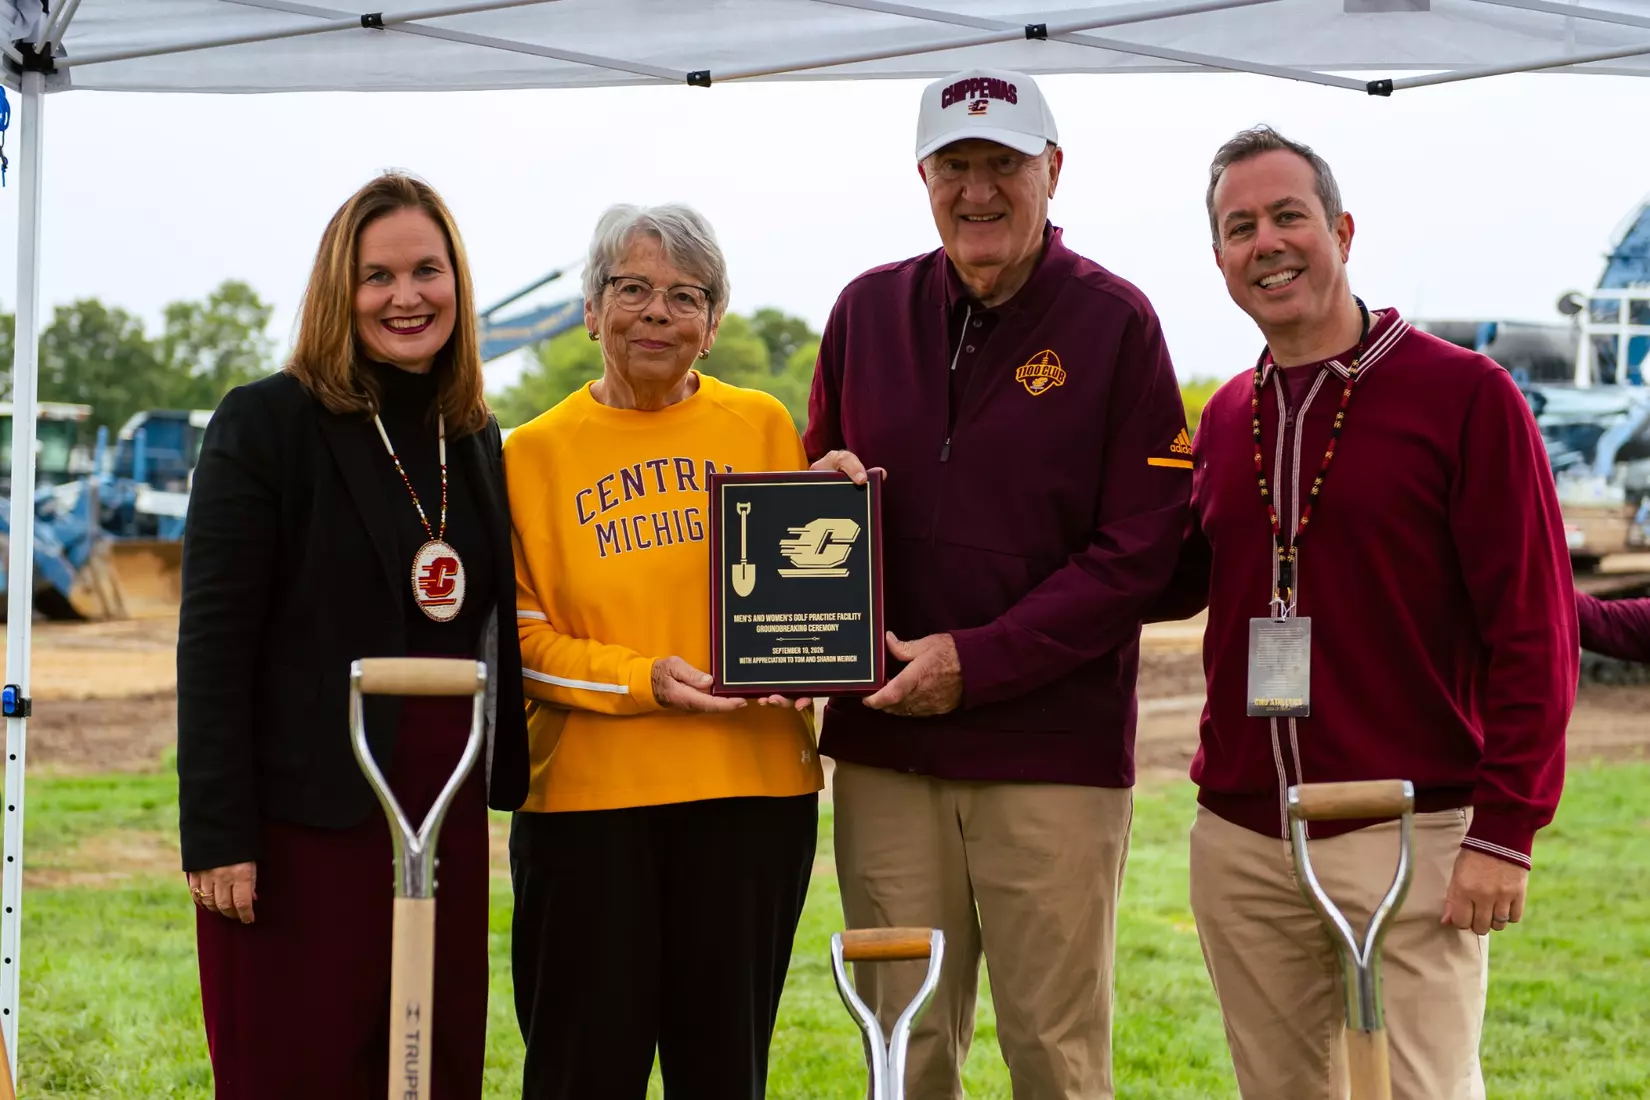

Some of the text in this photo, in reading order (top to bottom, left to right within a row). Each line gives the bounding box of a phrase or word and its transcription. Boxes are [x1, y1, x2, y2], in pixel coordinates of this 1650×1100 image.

[942, 77, 1017, 109] CHIPPEWAS
[1018, 366, 1064, 382] 1100 CLUB
[575, 457, 733, 526] CENTRA
[595, 507, 709, 558] MICHIG
[734, 612, 861, 623] MEN'S AND WOMEN'S GOLF PRACTICE FACILITY
[756, 624, 839, 633] GROUNDBREAKING CEREMONY
[772, 647, 801, 655] SEPTEMBER
[753, 656, 787, 664] APPRECIATION
[817, 655, 836, 663] SHARON
